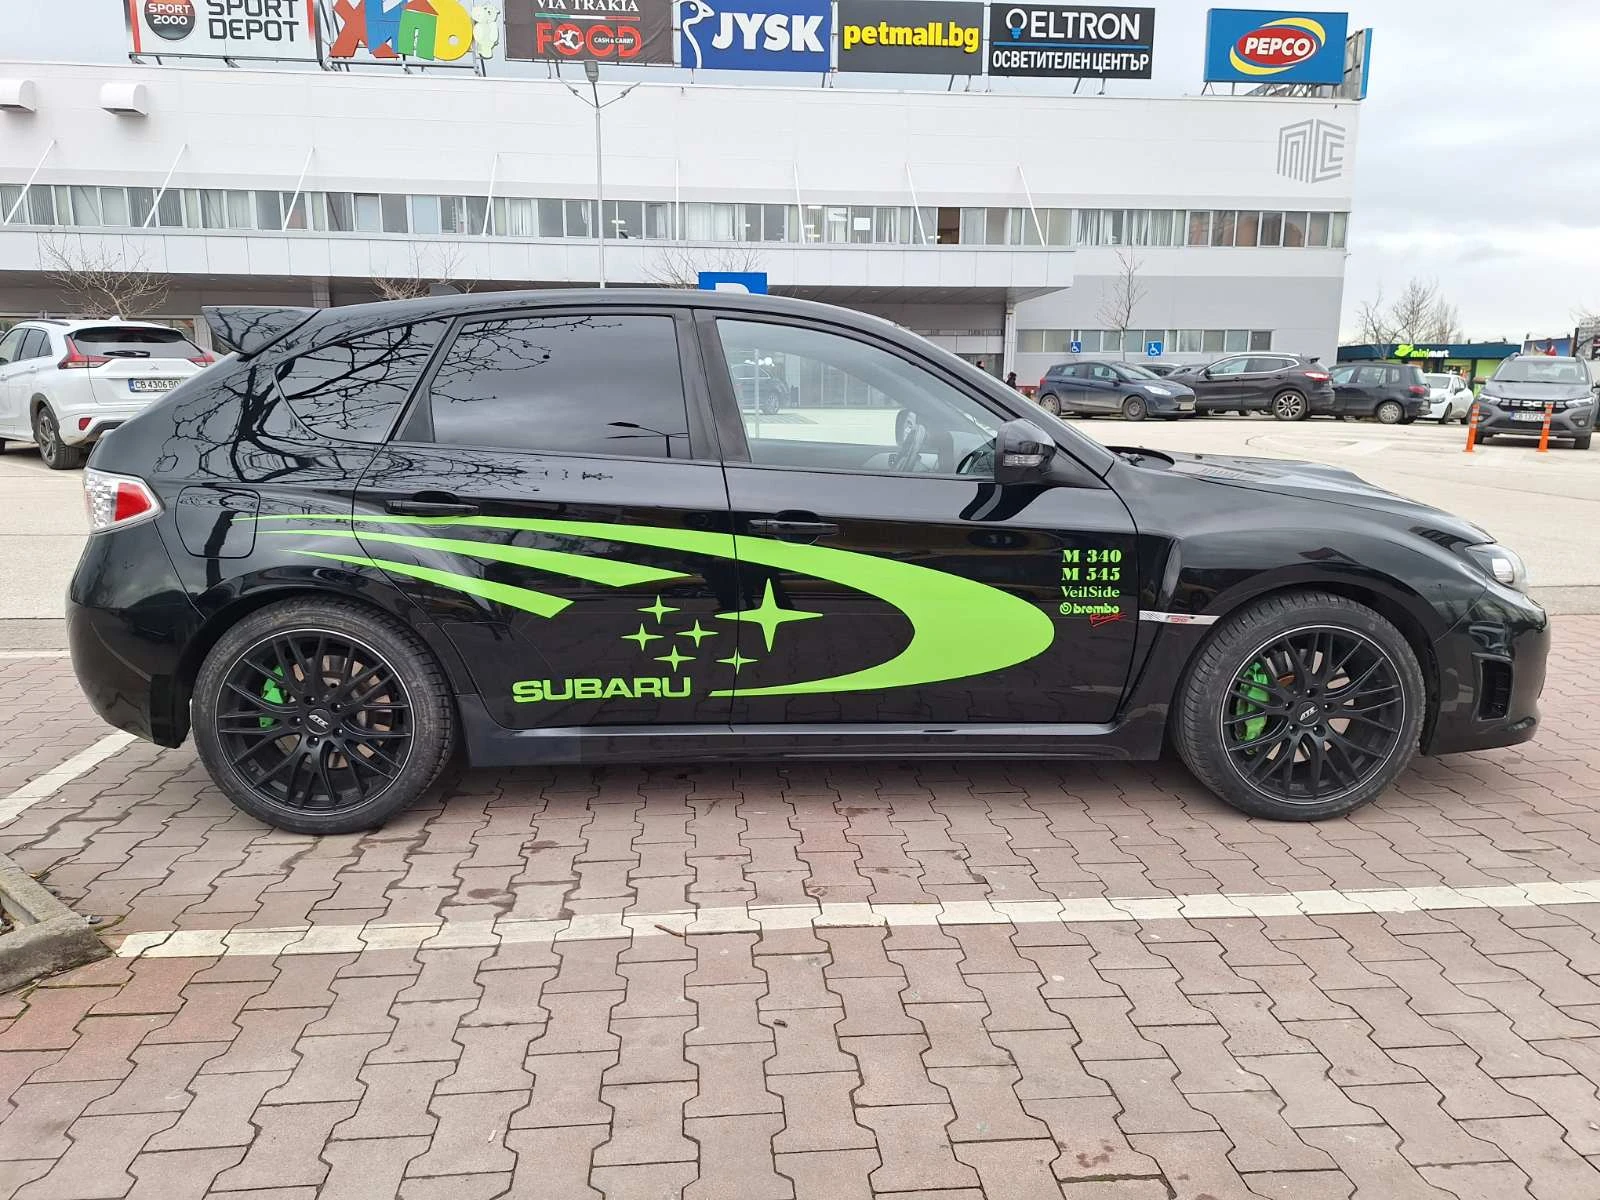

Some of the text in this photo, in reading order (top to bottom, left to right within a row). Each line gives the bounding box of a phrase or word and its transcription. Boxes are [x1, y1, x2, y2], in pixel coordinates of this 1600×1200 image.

[148, 3, 191, 14] SPORT
[205, 0, 299, 18] SPORT
[153, 14, 188, 26] 2000
[1030, 12, 1140, 41] ELTRON
[208, 18, 299, 42] DEPOT
[536, 22, 642, 57] FOOD
[711, 12, 825, 52] JYSK
[842, 21, 980, 54] petmall.bg
[1244, 37, 1311, 57] PEPCO
[992, 50, 1150, 73] ОСВЕТИТЕЛЕН ЦЕНТЪР
[147, 380, 168, 389] 4306
[1061, 549, 1122, 564] M 340
[1061, 567, 1121, 582] M 545
[1061, 585, 1121, 599] VeilSide
[1073, 602, 1120, 615] brembo
[512, 676, 692, 703] SUBARU
